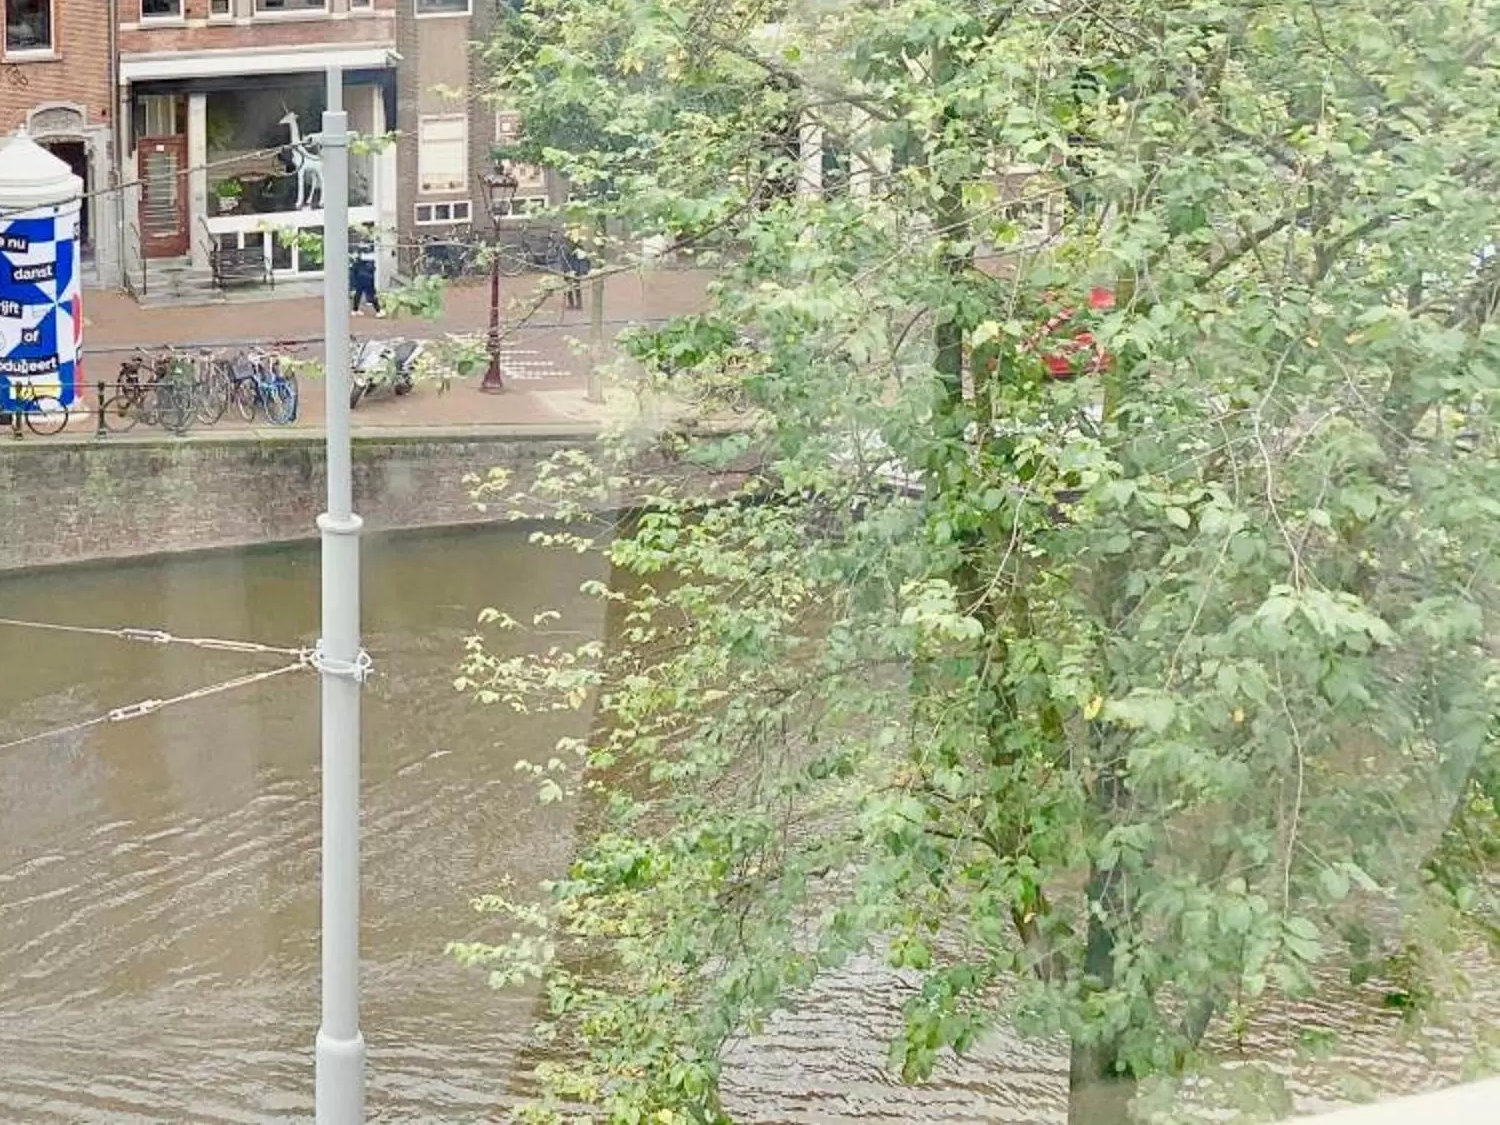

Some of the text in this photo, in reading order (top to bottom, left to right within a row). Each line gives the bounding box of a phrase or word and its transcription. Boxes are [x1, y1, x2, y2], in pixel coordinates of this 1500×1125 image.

[7, 238, 26, 250] nu
[13, 265, 53, 280] danst
[23, 330, 40, 342] of
